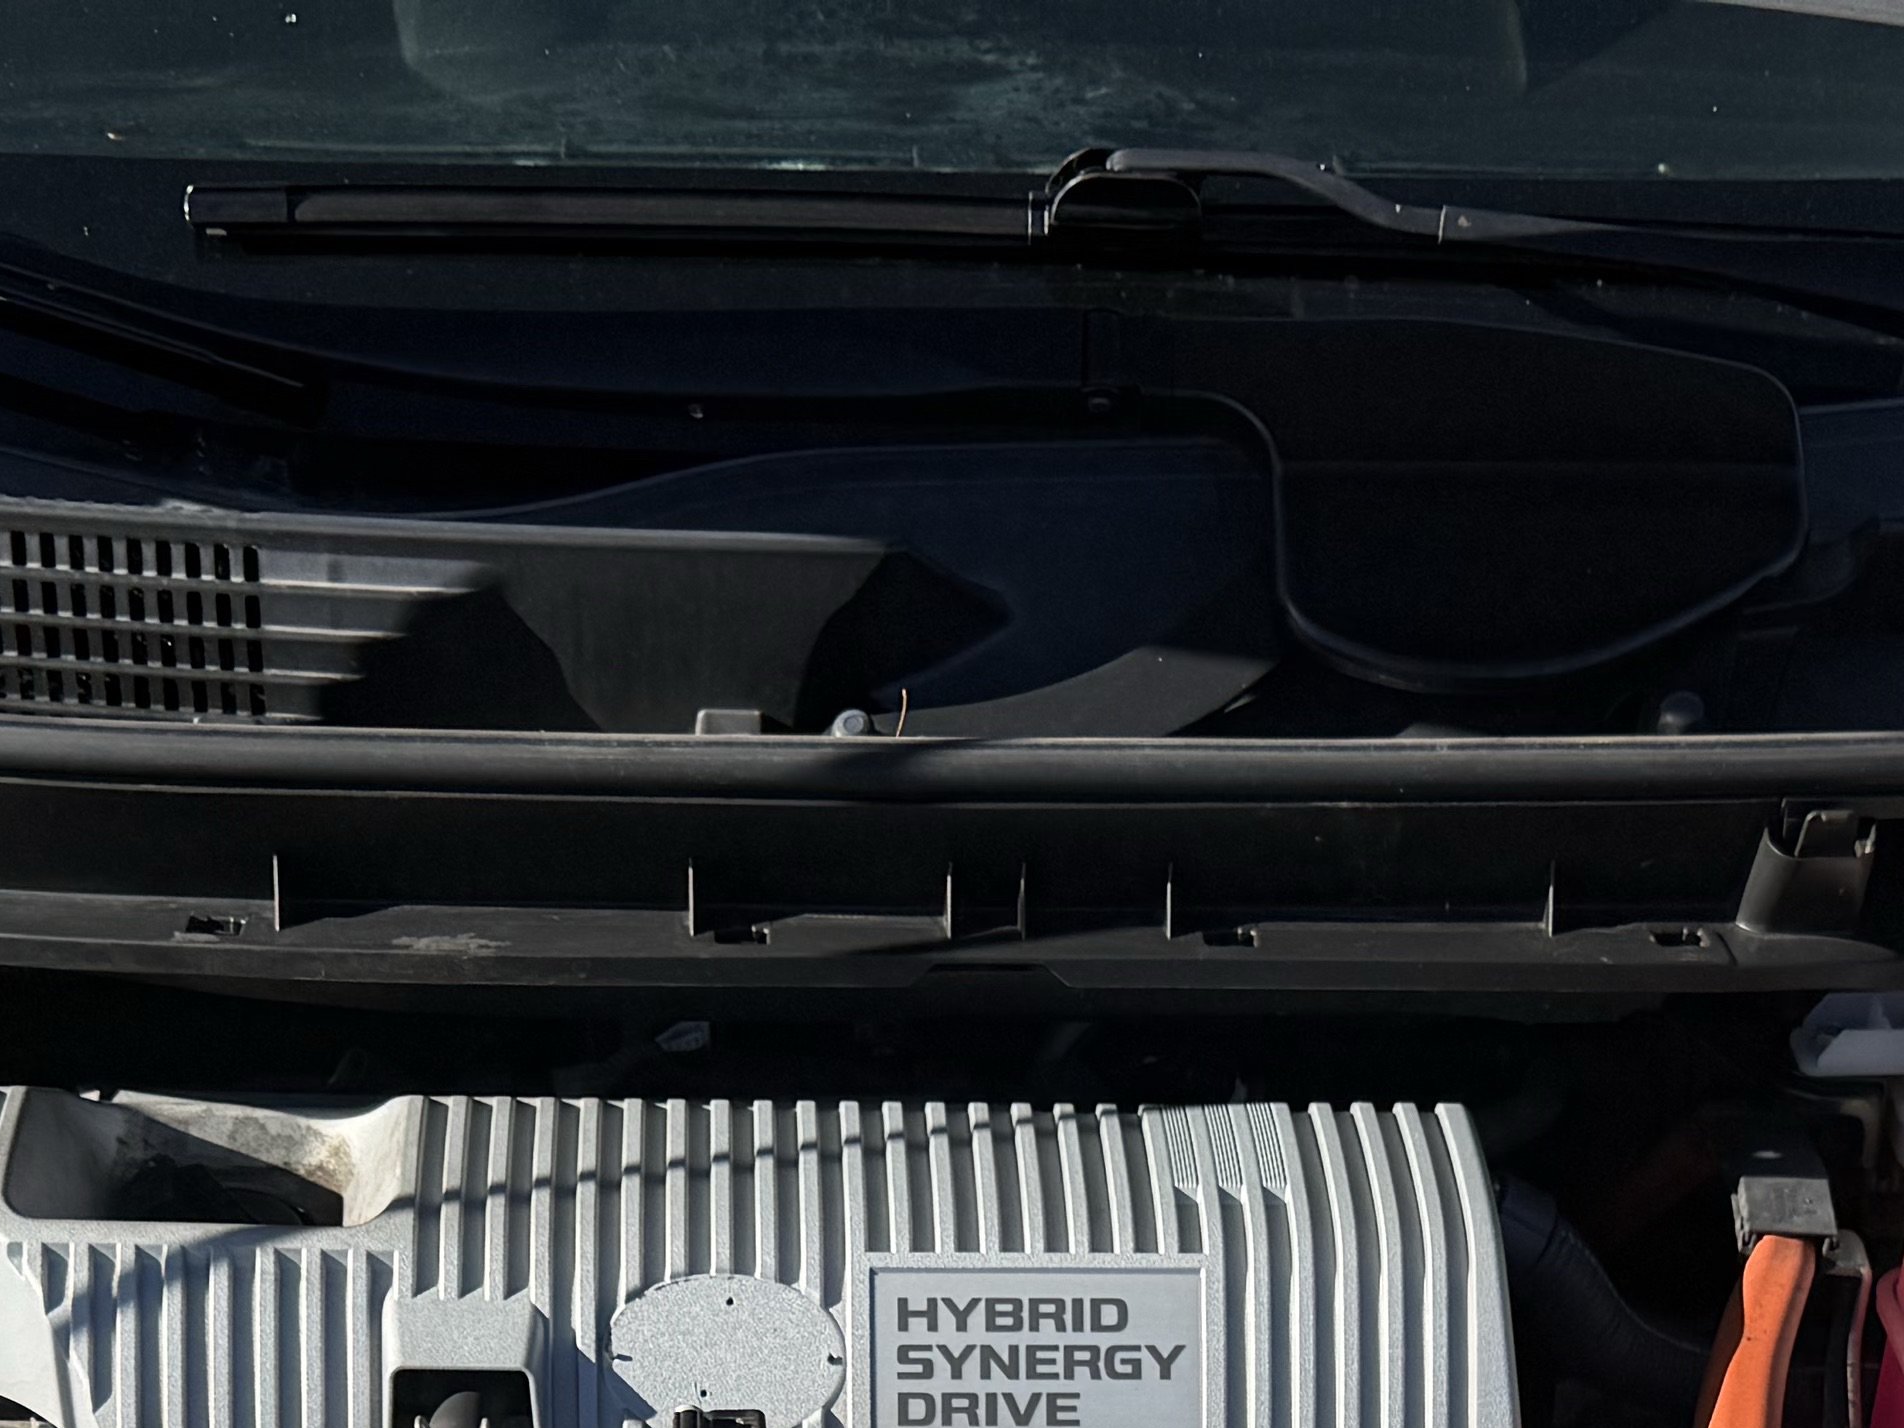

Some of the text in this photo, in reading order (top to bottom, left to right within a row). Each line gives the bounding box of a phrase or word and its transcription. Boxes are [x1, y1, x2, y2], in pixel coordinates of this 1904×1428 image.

[897, 1297, 1129, 1333] HYBRID
[897, 1344, 1187, 1381] SYNERGY
[897, 1392, 1081, 1427] DRIVE
